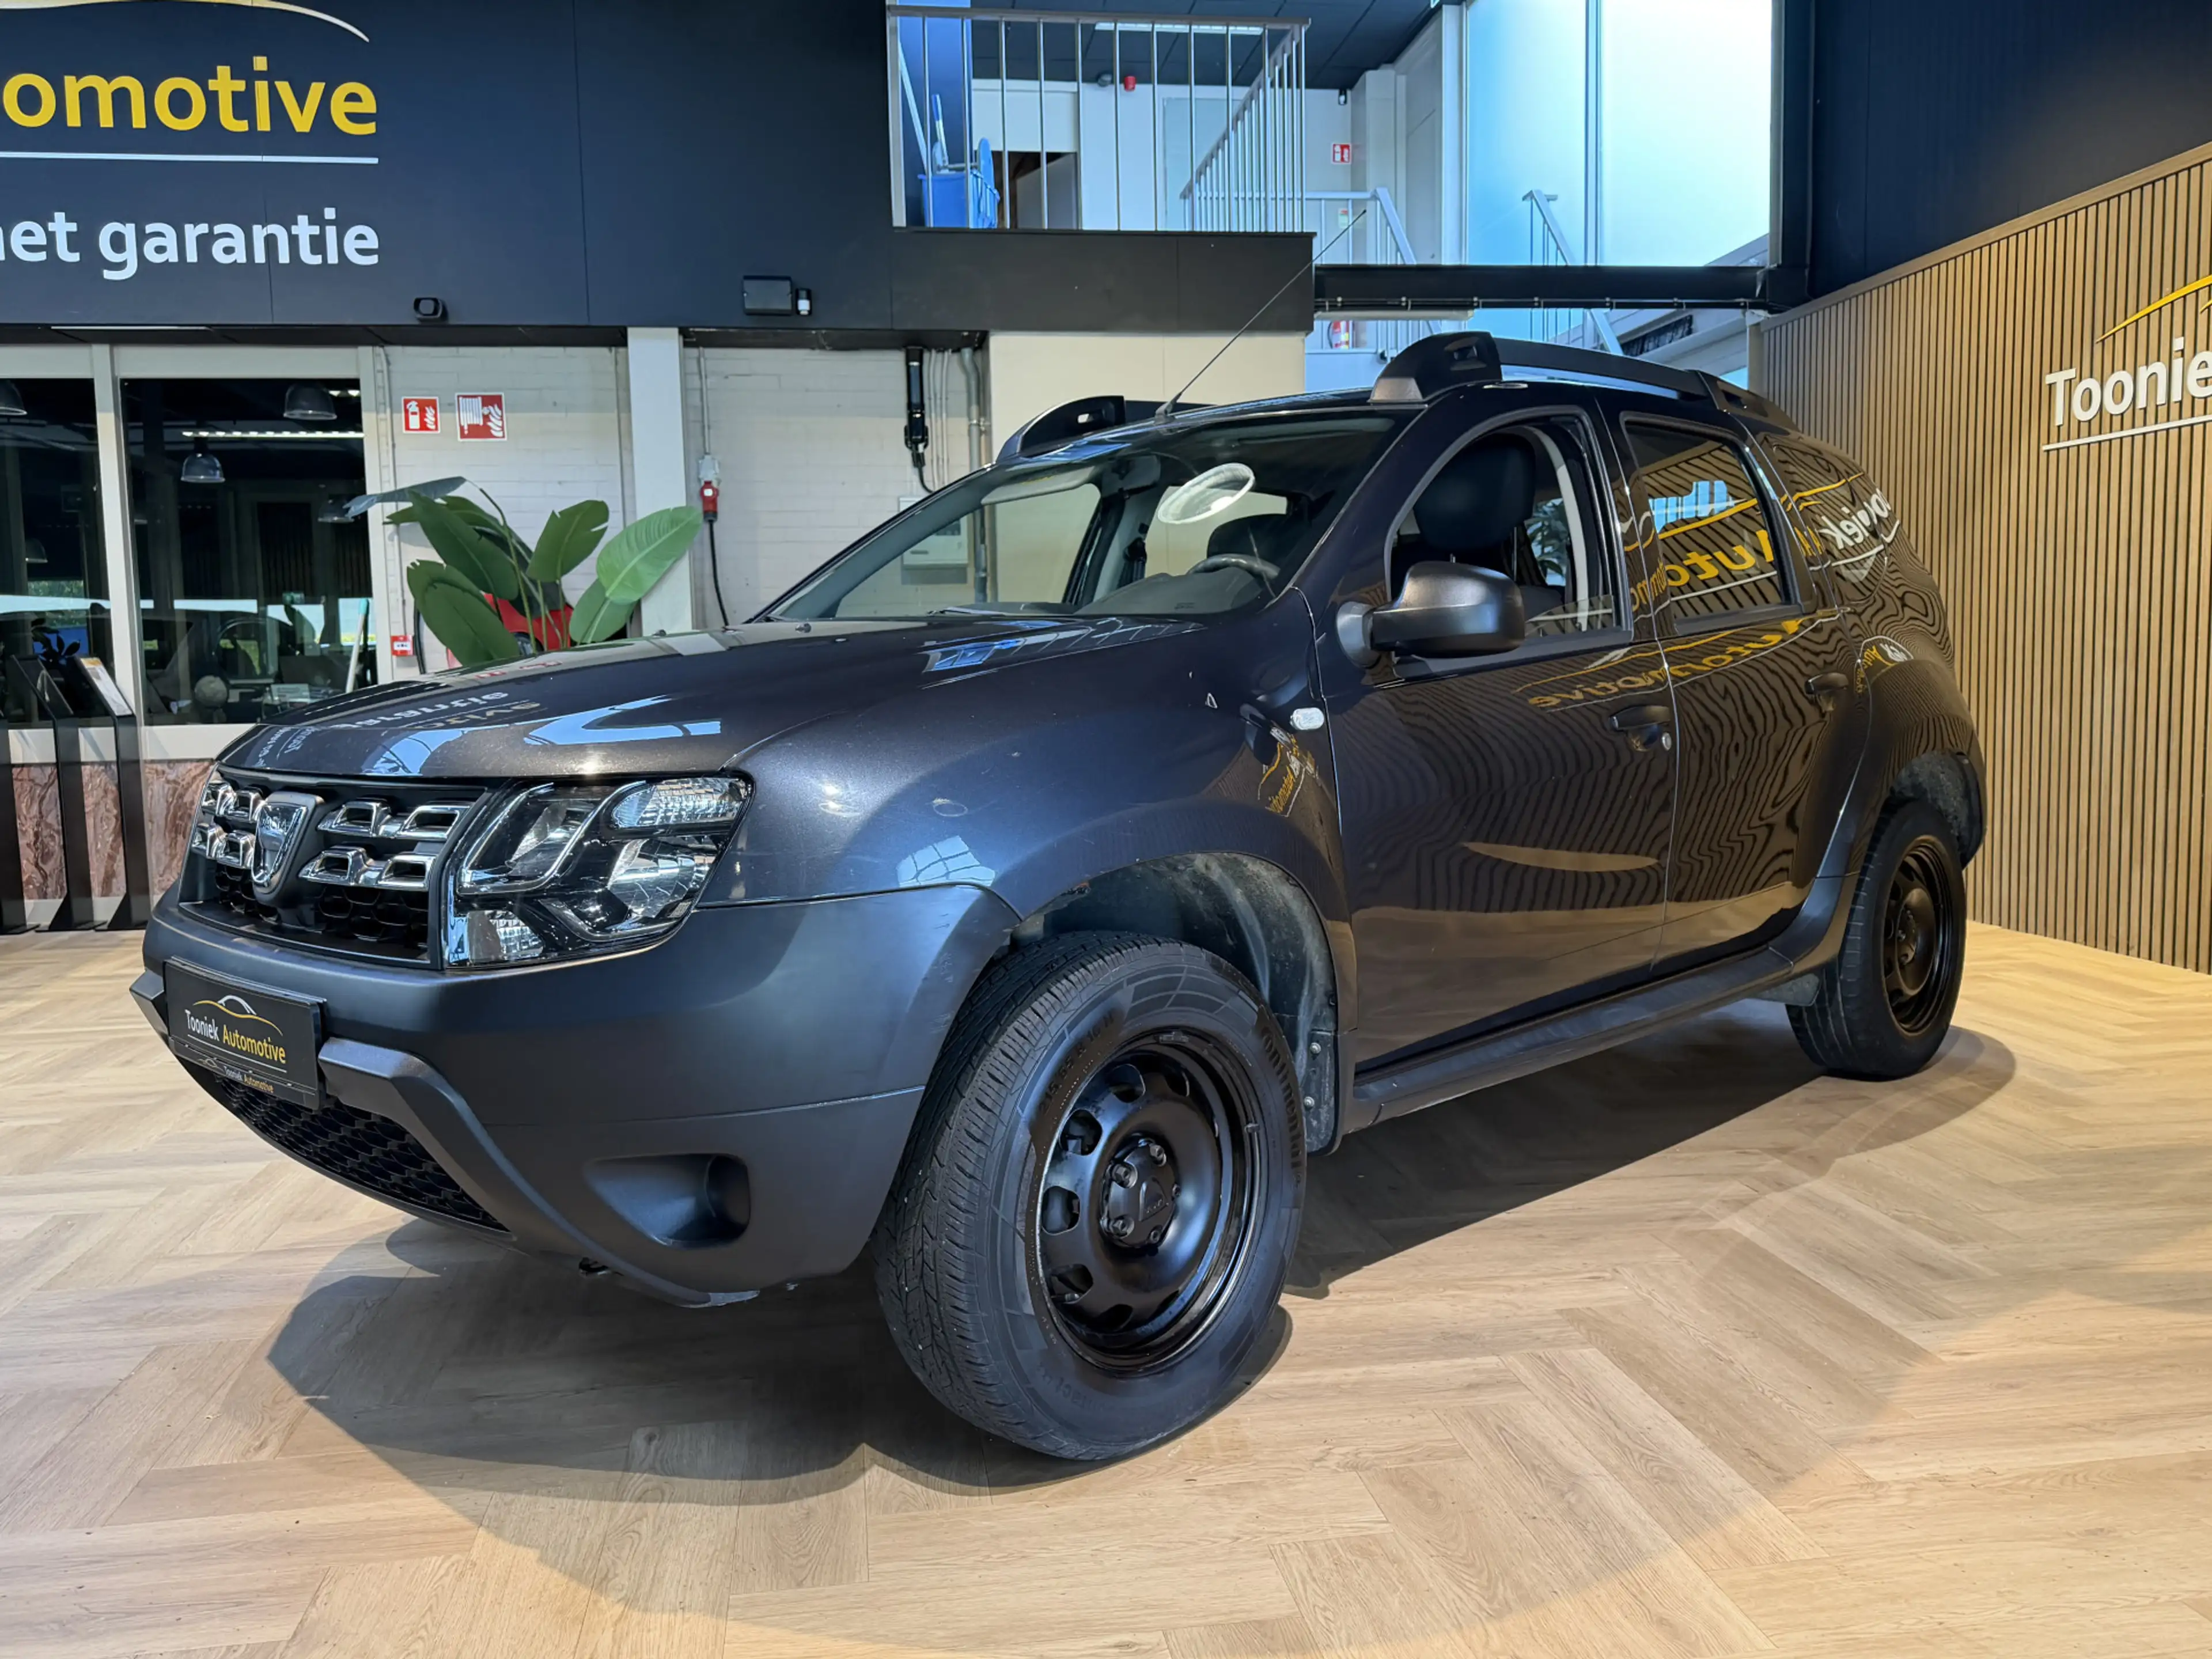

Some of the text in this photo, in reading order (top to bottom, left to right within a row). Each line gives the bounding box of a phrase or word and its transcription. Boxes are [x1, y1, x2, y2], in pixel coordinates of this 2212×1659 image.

[2, 56, 377, 135] omotive
[99, 207, 379, 281] garantie
[2045, 336, 2212, 426] Toonie
[184, 1009, 286, 1064] Tooniek Automotive
[1261, 1028, 1302, 1169] Continental
